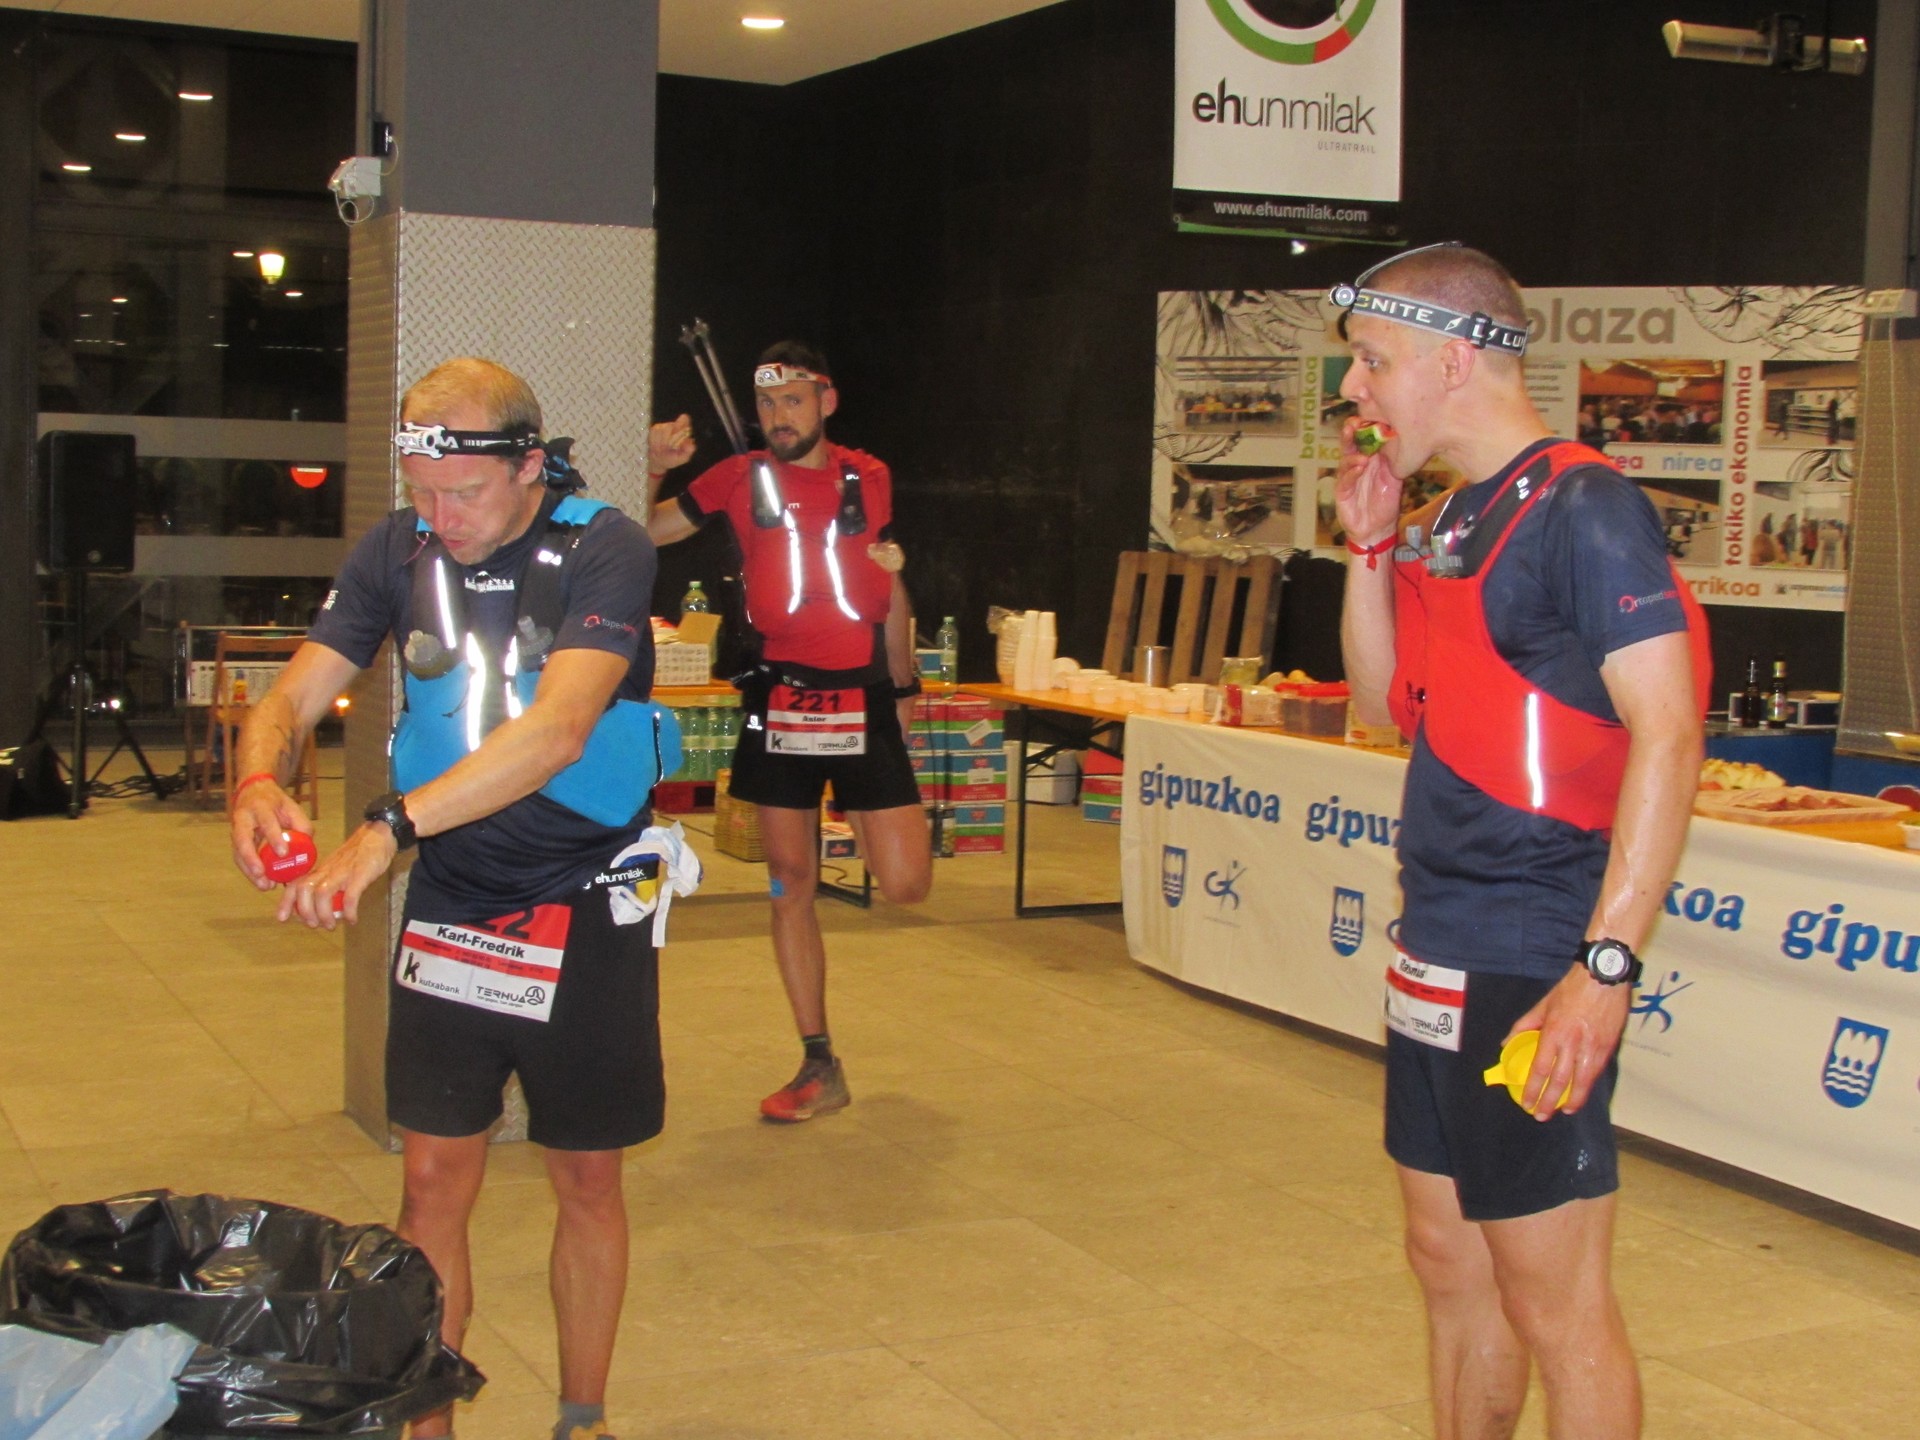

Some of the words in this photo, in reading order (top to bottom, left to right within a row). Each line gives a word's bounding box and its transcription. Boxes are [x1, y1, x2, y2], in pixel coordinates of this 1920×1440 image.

[1192, 77, 1376, 135] ehunmilak
[1317, 141, 1376, 154] ULTRATRAIL
[1213, 201, 1368, 222] www.ehunmilak.com
[1300, 357, 1317, 459] bertakoa
[1729, 366, 1753, 485] ekonomia
[1662, 452, 1723, 472] nirea
[1724, 492, 1745, 566] tokiko
[788, 689, 841, 711] 221
[1139, 762, 1280, 824] gipuzkoa
[595, 868, 644, 884] ehunmilak
[436, 925, 526, 959] Karl-Fredrik
[1781, 903, 1920, 973] gipu
[419, 976, 460, 996] kutxabank
[476, 985, 526, 1004] TERNUA
